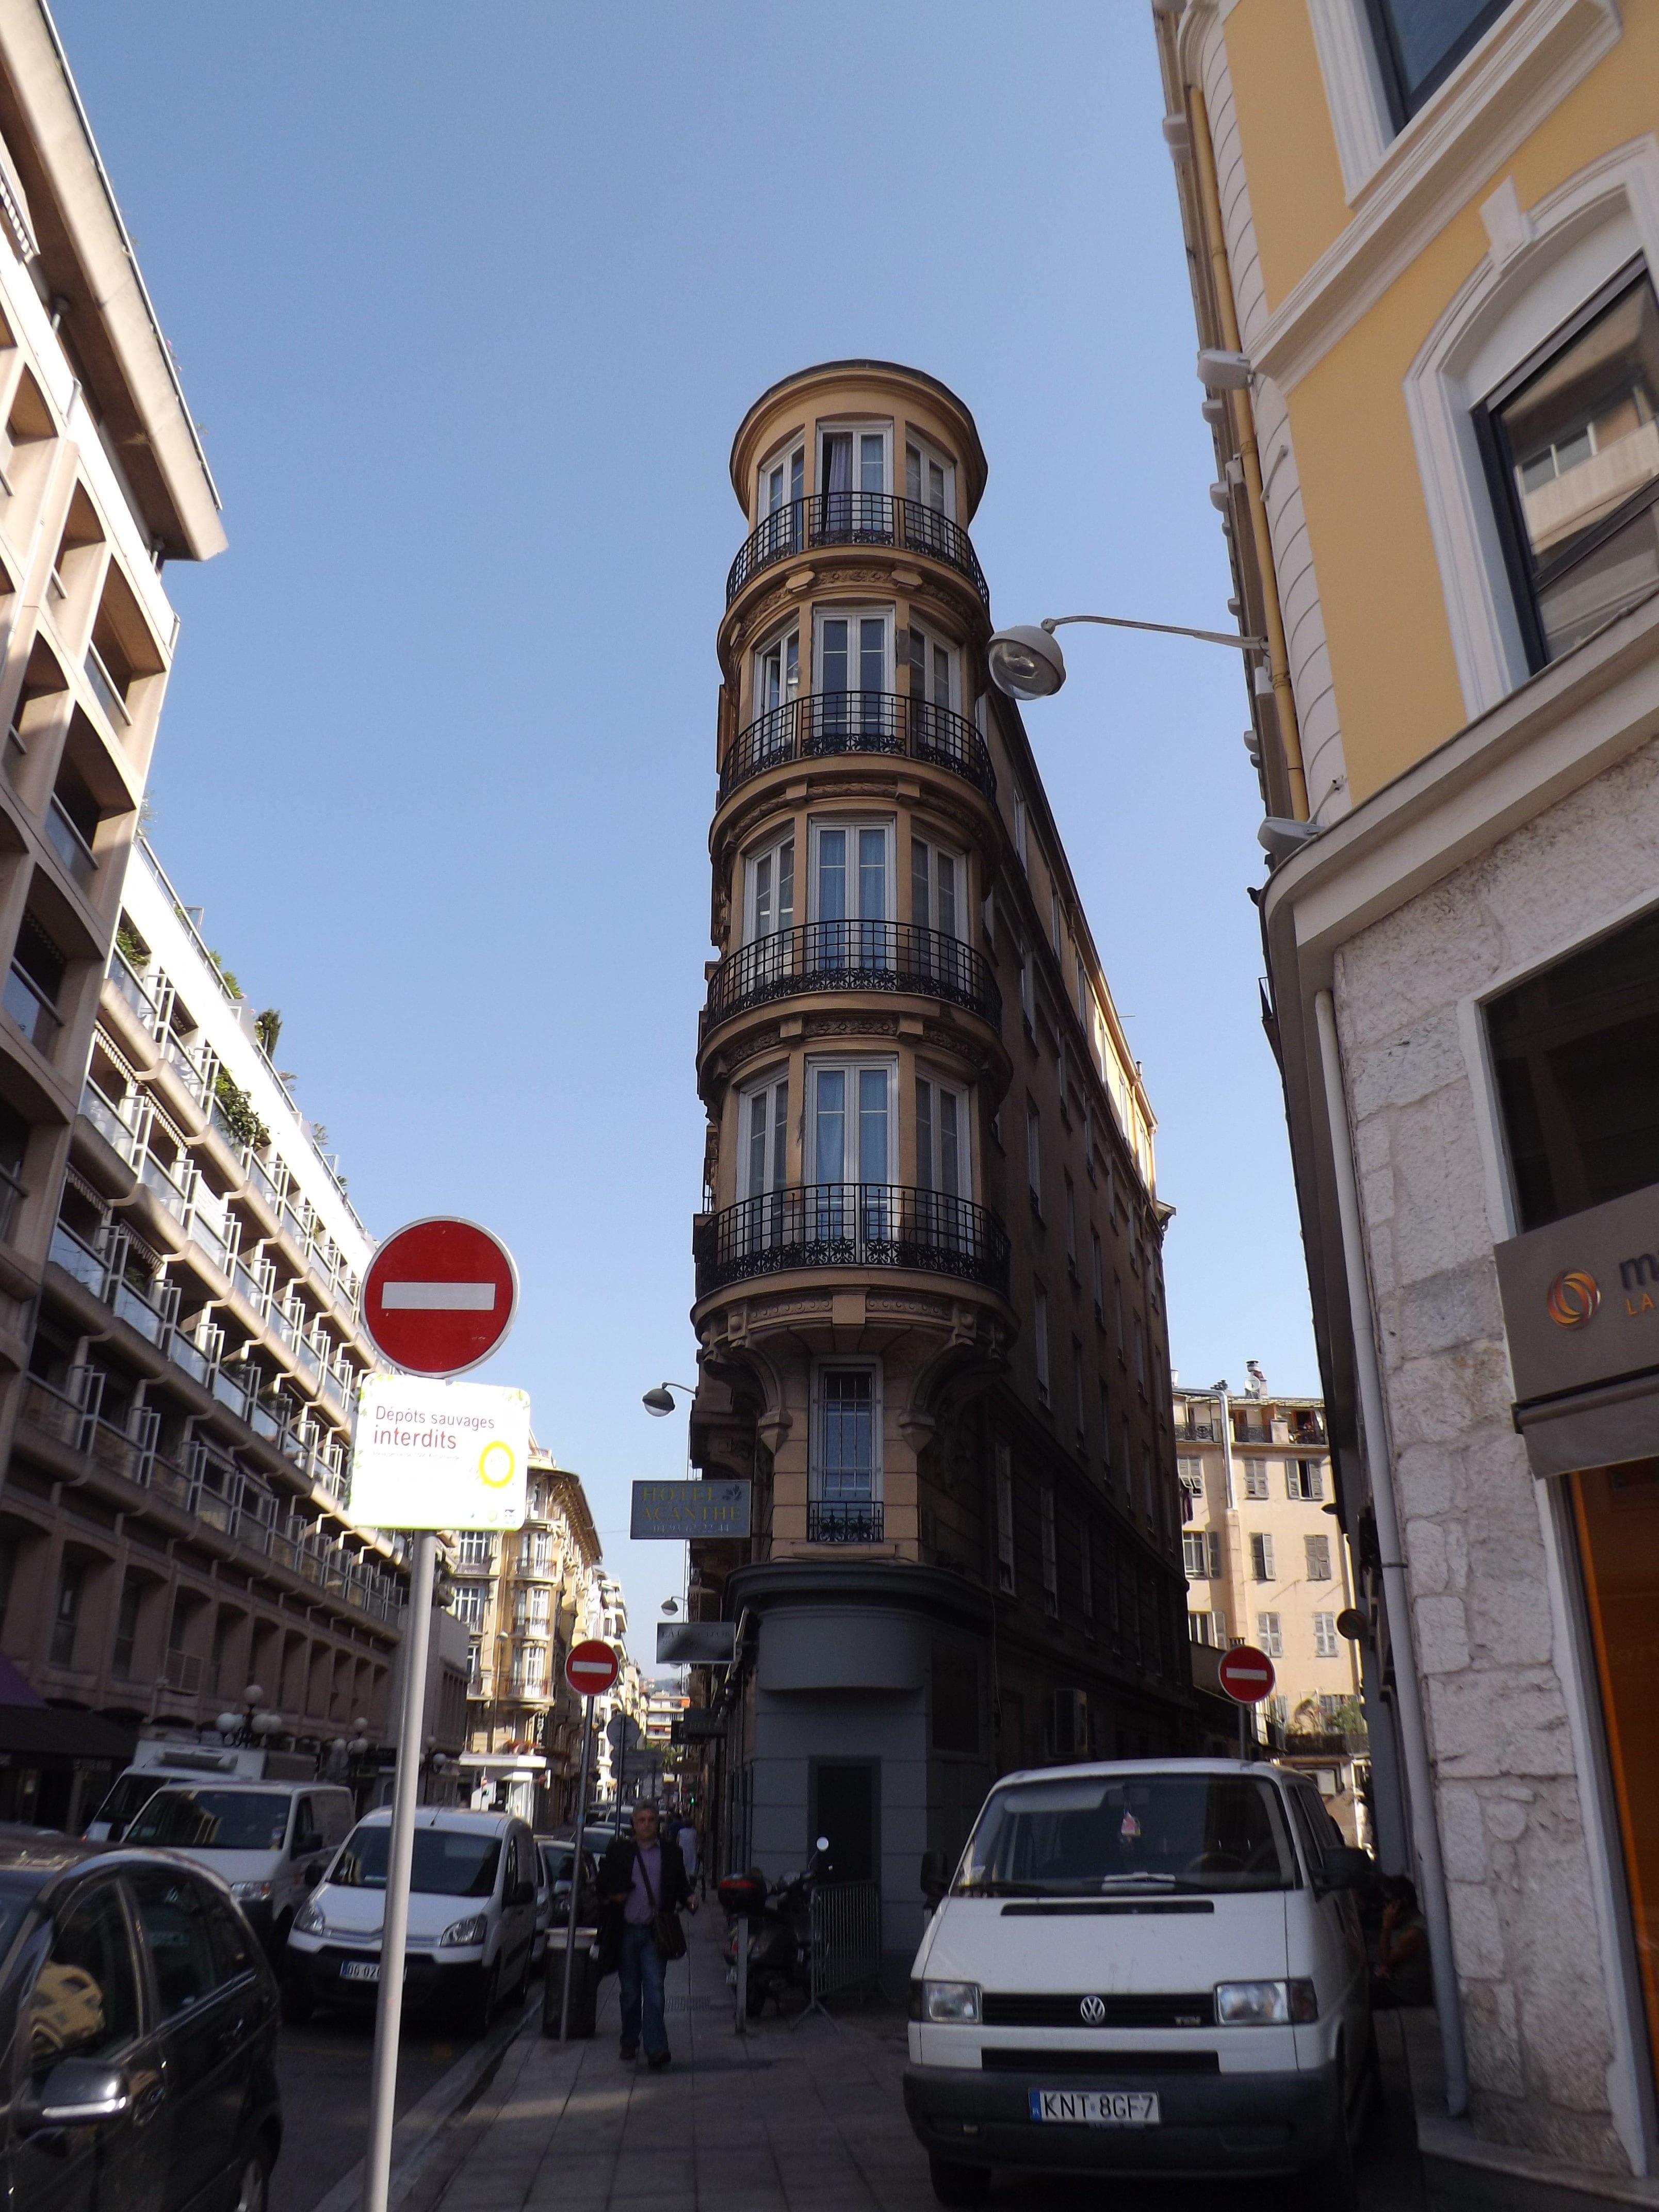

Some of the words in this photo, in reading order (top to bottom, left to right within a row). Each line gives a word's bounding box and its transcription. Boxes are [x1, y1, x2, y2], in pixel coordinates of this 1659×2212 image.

[1619, 1251, 1659, 1291] m
[1625, 1293, 1655, 1316] LA
[376, 1405, 426, 1424] Dépôts
[431, 1413, 495, 1431] sauvages
[374, 1424, 457, 1449] interdits
[642, 1486, 717, 1502] HOTEL
[642, 1505, 739, 1520] ACANTHE
[1043, 2092, 1089, 2119] KNT
